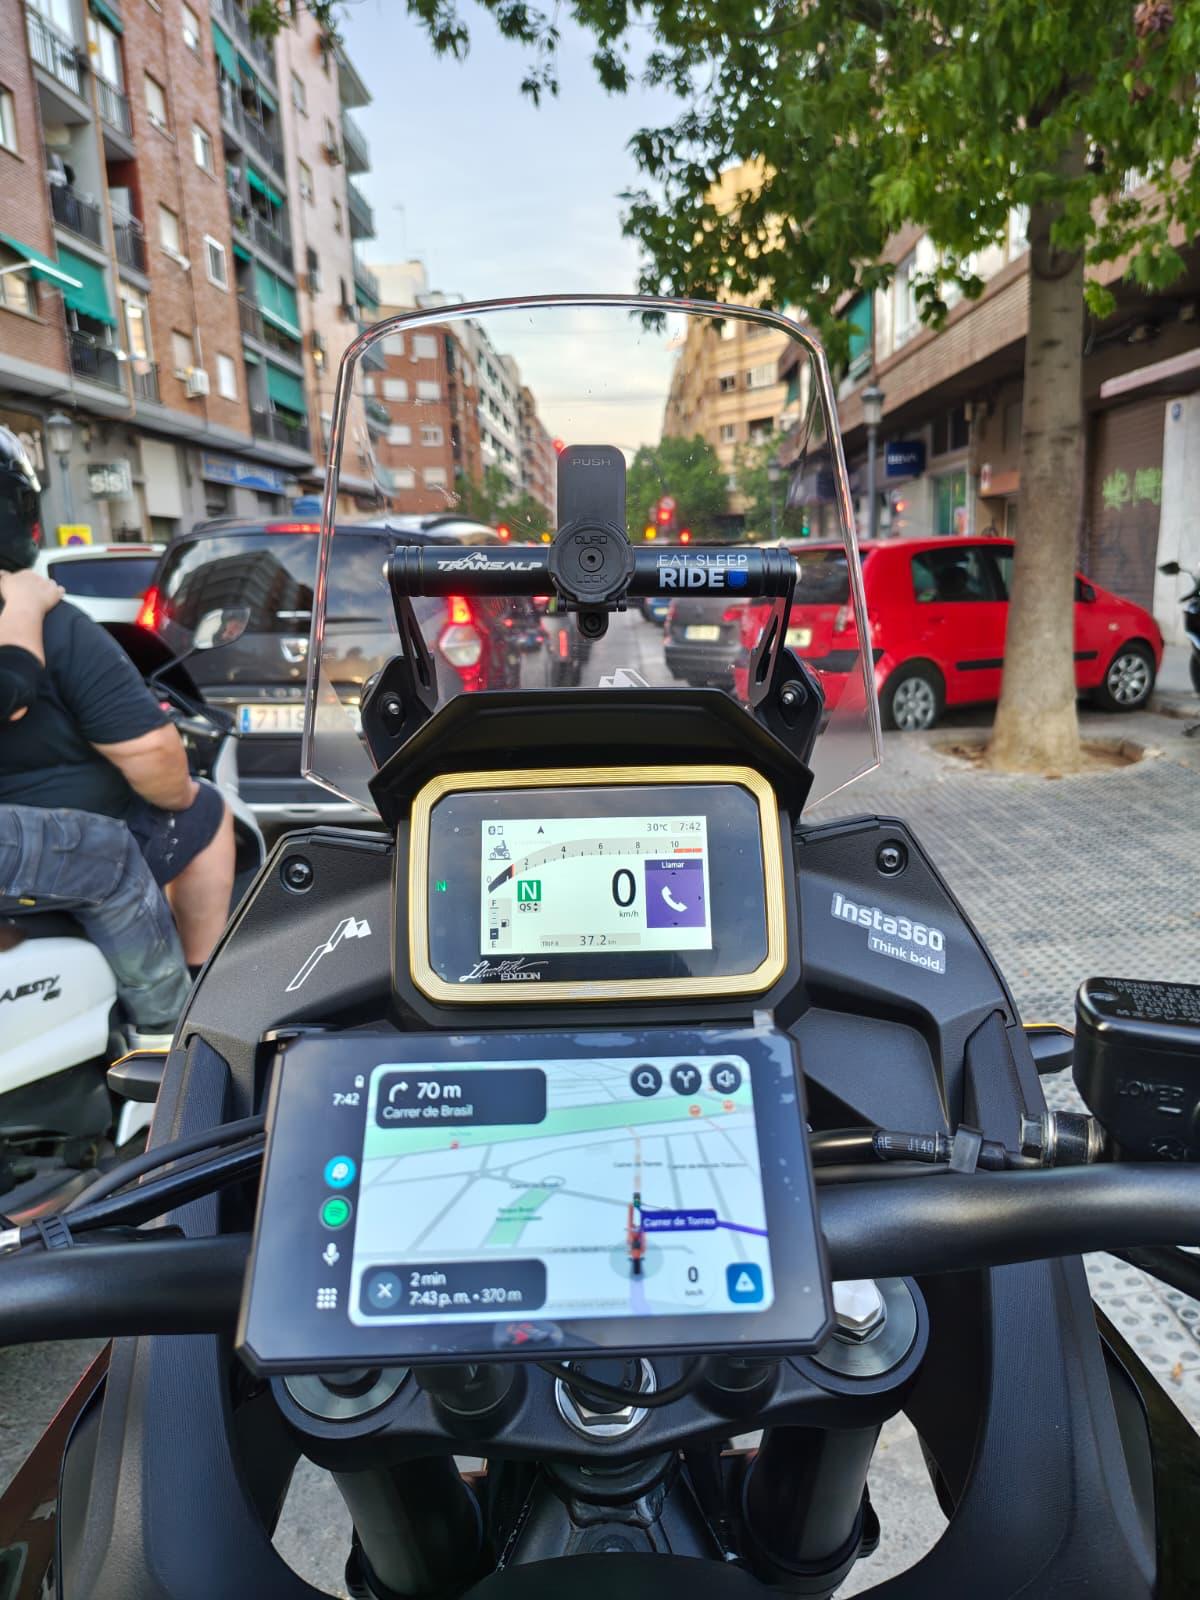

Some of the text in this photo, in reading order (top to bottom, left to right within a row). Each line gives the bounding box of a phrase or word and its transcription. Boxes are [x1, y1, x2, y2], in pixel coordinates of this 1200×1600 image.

[572, 458, 611, 467] PUSH
[575, 535, 607, 545] QUAD
[437, 557, 543, 572] TRANSALP
[696, 554, 748, 567] SLEEP
[576, 574, 608, 584] LOCK
[659, 567, 725, 588] RIDE
[680, 821, 702, 832] 7:42
[561, 845, 567, 853] 4
[598, 842, 604, 850] 6
[635, 841, 641, 849] 8
[670, 840, 680, 849] 10
[523, 858, 529, 866] 2
[661, 861, 685, 869] Llamar
[436, 880, 448, 892] N
[521, 881, 538, 900] N
[611, 868, 637, 908] 0
[491, 899, 497, 907] F
[519, 902, 532, 913] QS
[619, 910, 639, 918] km/h
[834, 895, 943, 952] Insta360
[491, 940, 497, 949] E
[580, 934, 607, 946] 37.2
[871, 937, 945, 972] Think bold.
[500, 971, 541, 981] EDITION
[417, 1082, 462, 1100] 70 m
[332, 1092, 360, 1107] 7:42
[382, 1104, 474, 1119] Carrer de Brasil
[643, 1216, 716, 1227] Carrer de Torres
[409, 1271, 447, 1287] 2 min
[687, 1265, 699, 1284] 0
[408, 1290, 437, 1307] 7:43
[480, 1288, 506, 1304] 370
[507, 1289, 523, 1303] m
